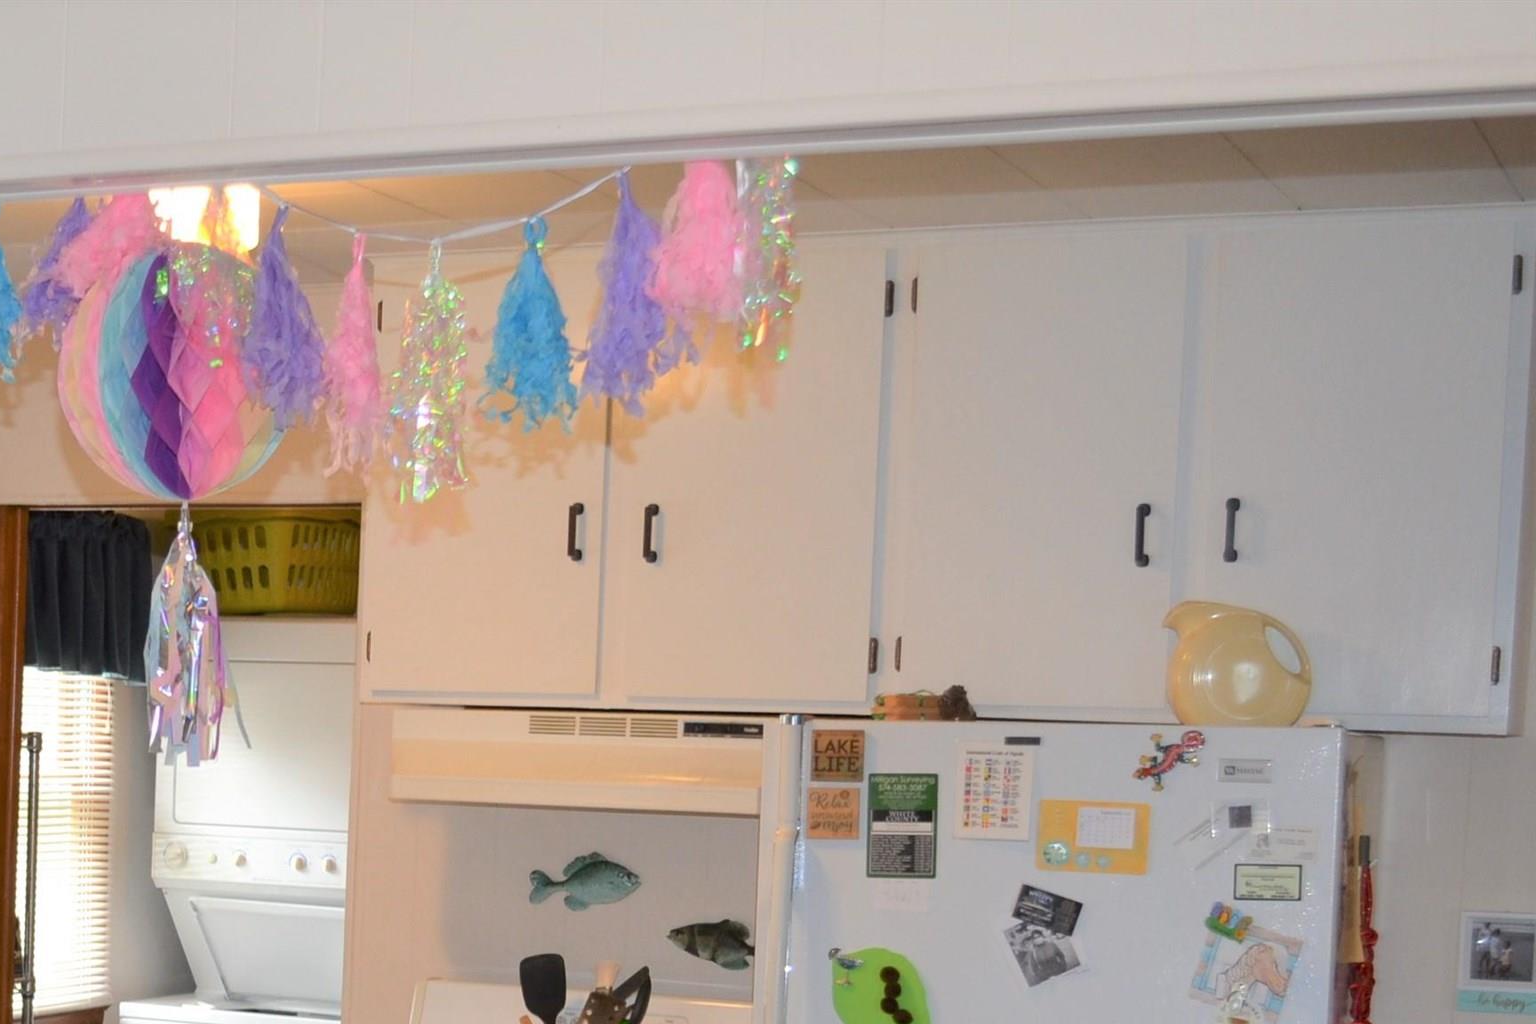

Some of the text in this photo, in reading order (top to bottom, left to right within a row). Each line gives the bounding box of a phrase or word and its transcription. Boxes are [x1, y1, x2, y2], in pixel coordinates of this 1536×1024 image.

[813, 739, 860, 754] LAKE
[813, 756, 860, 773] LIFE
[808, 790, 851, 810] Relax
